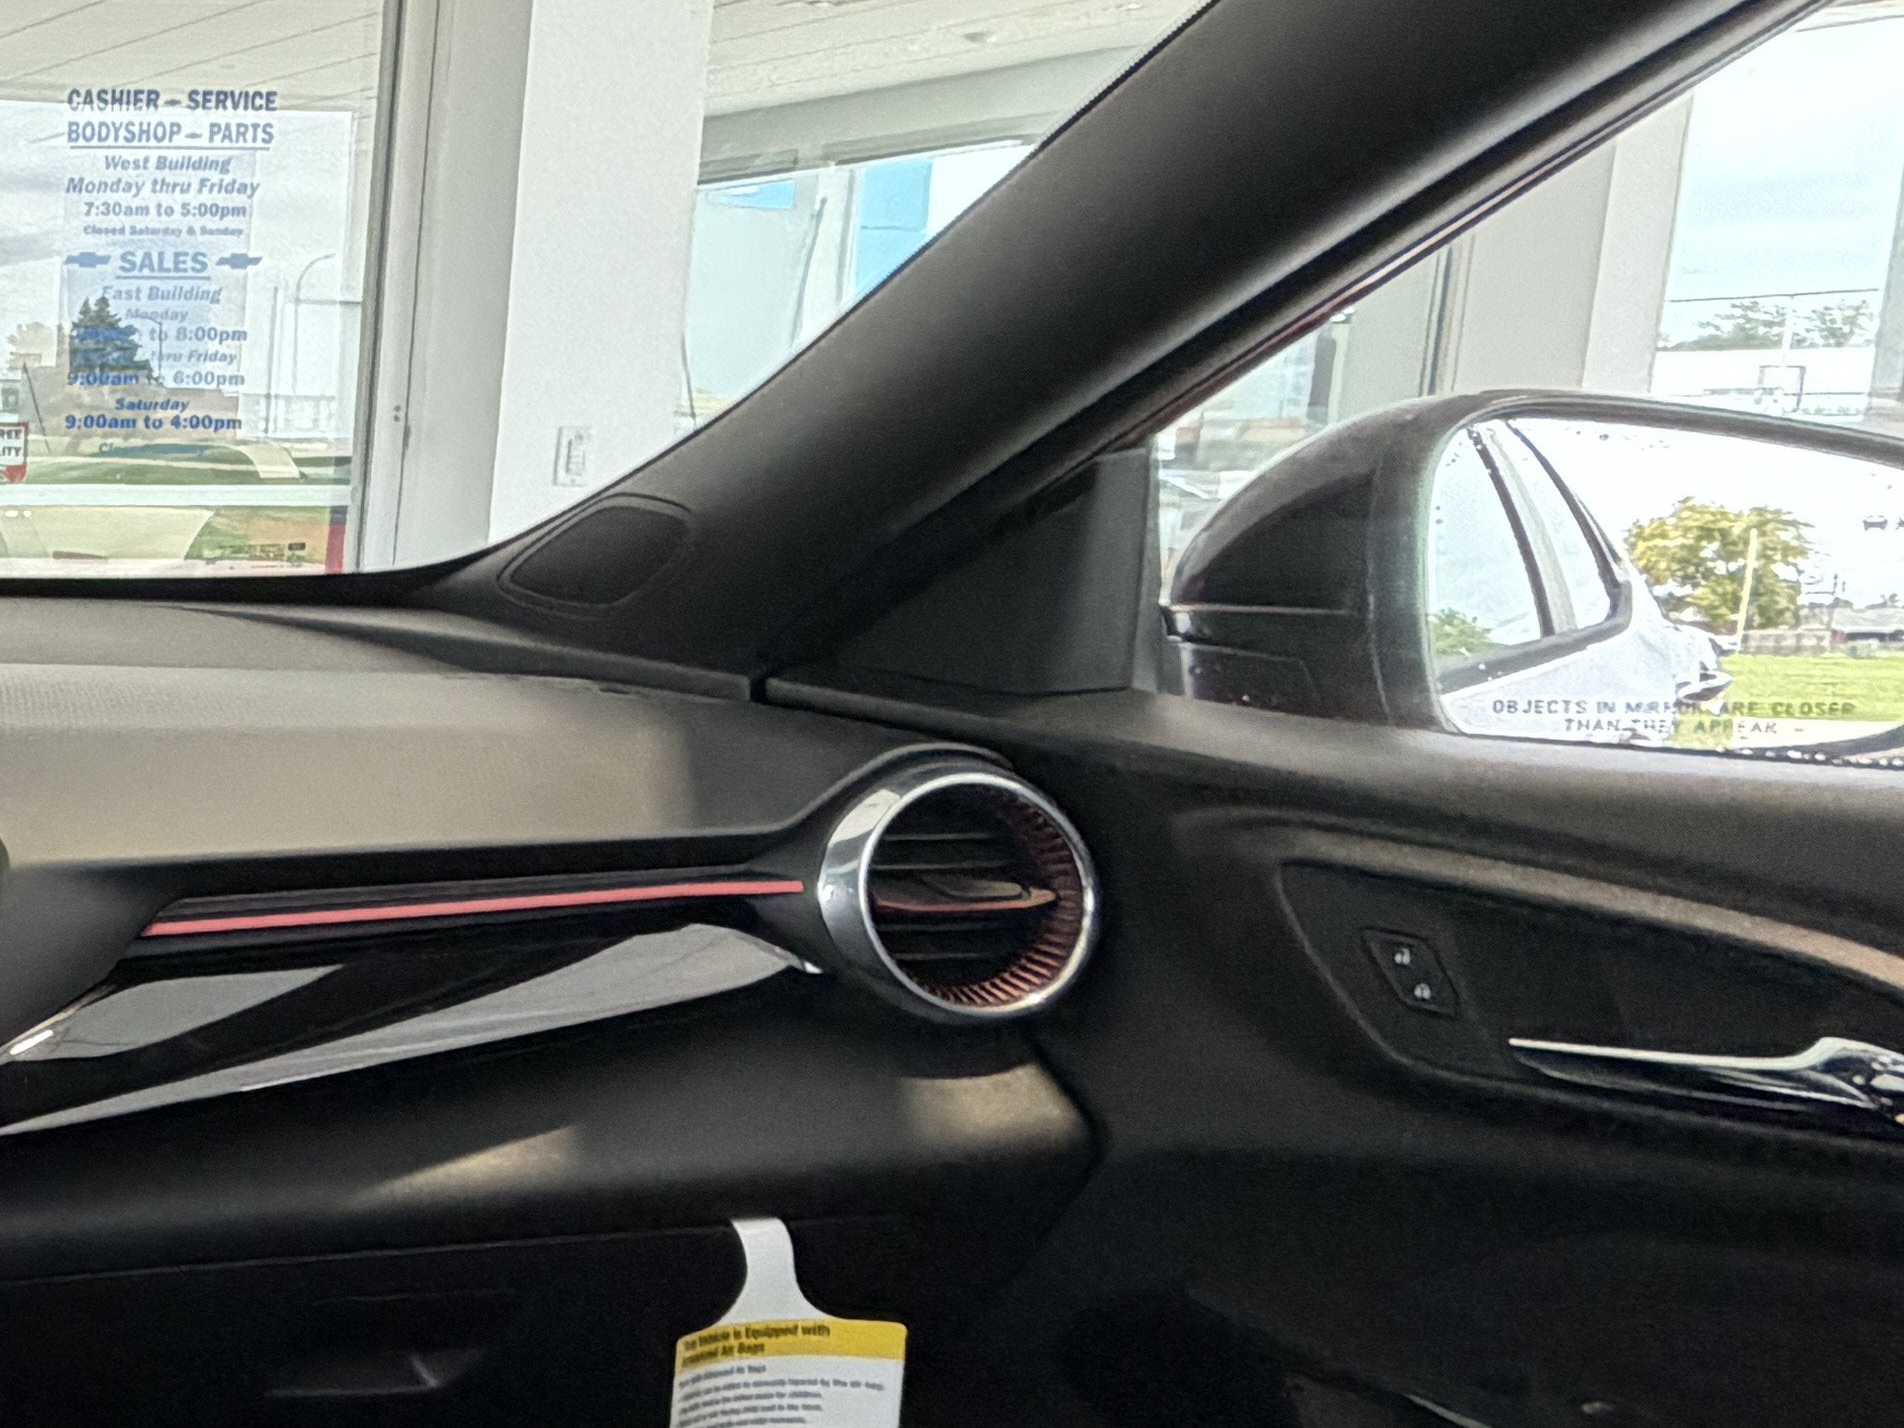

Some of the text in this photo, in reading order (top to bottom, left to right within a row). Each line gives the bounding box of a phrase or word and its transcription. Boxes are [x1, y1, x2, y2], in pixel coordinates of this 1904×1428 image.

[67, 88, 278, 112] CASHIER SERVICE
[67, 121, 275, 145] BODYSHOP PARTS
[104, 155, 233, 174] West Building
[65, 177, 261, 199] Monday thru Friday
[83, 201, 247, 221] 7:30am to 5:00pm
[118, 251, 209, 274] SALES
[147, 285, 223, 304] Building
[125, 308, 189, 323] Monday
[176, 327, 248, 345] 8:00pm
[187, 350, 237, 365] Friday
[172, 371, 246, 388] 6:00pm
[114, 397, 190, 412] Saturday
[65, 414, 243, 432] 9:00am to 4:00pm
[1492, 699, 1587, 715] OBJECTS
[1596, 700, 1616, 714] IN
[1719, 701, 1758, 716] ARE
[1770, 701, 1857, 717] CLOSER
[1565, 717, 1620, 731] THAN
